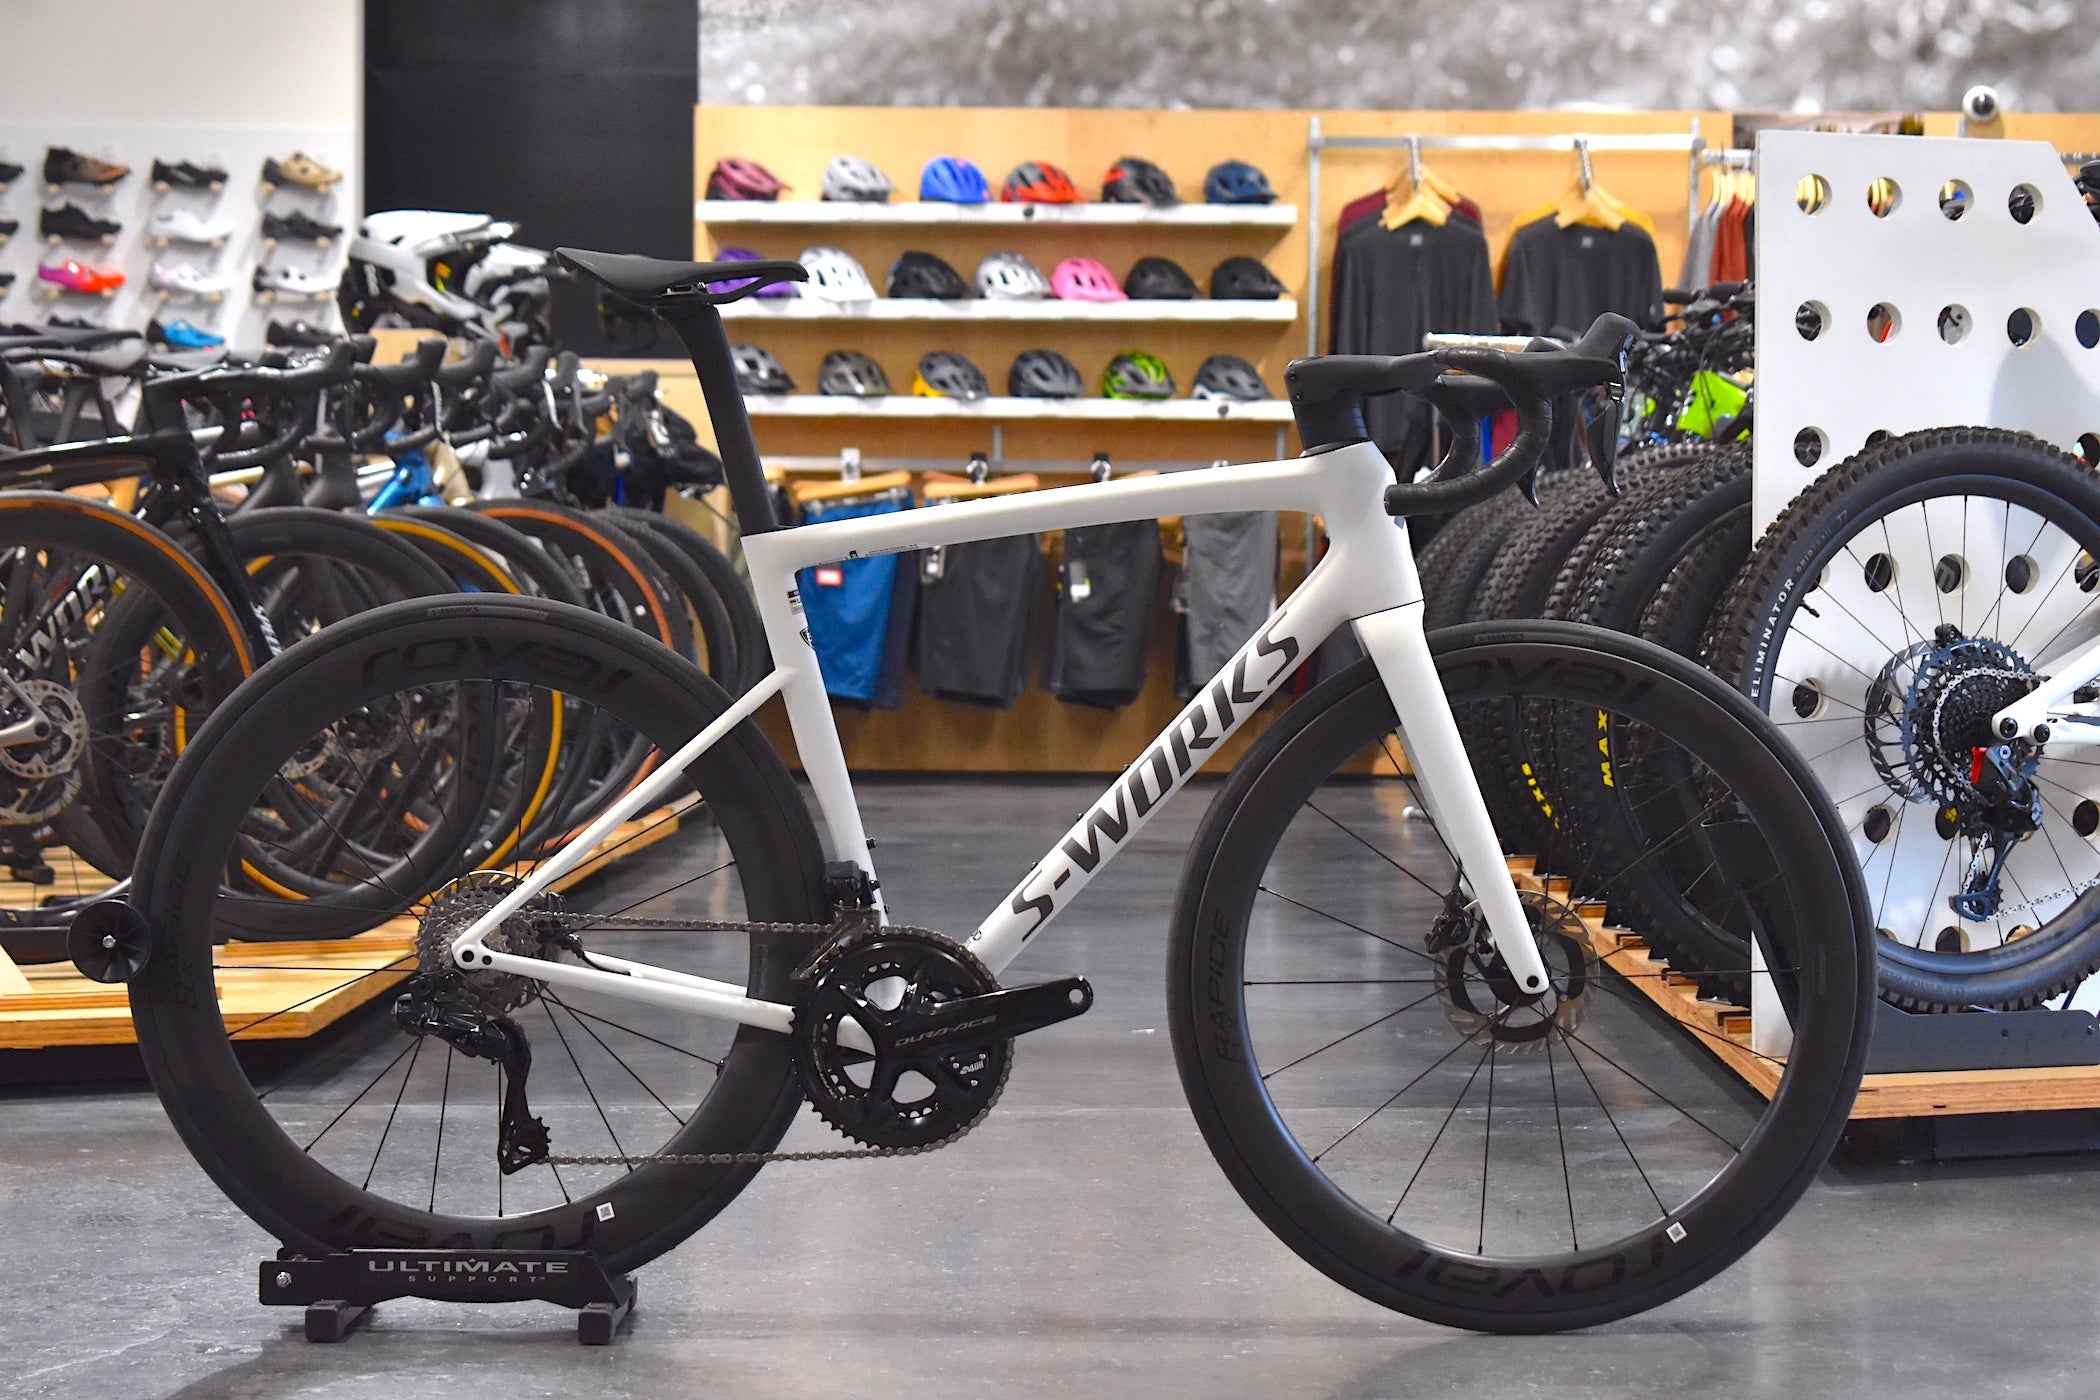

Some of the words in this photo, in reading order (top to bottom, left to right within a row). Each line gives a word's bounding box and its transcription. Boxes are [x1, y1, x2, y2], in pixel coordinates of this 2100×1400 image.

[1751, 578, 1795, 698] ELIMINATOR
[1011, 611, 1300, 942] S-WORKS
[895, 1014, 998, 1047] DURA-ACE
[1208, 908, 1232, 1064] RAPIDE
[368, 1258, 569, 1274] ULTIMATE
